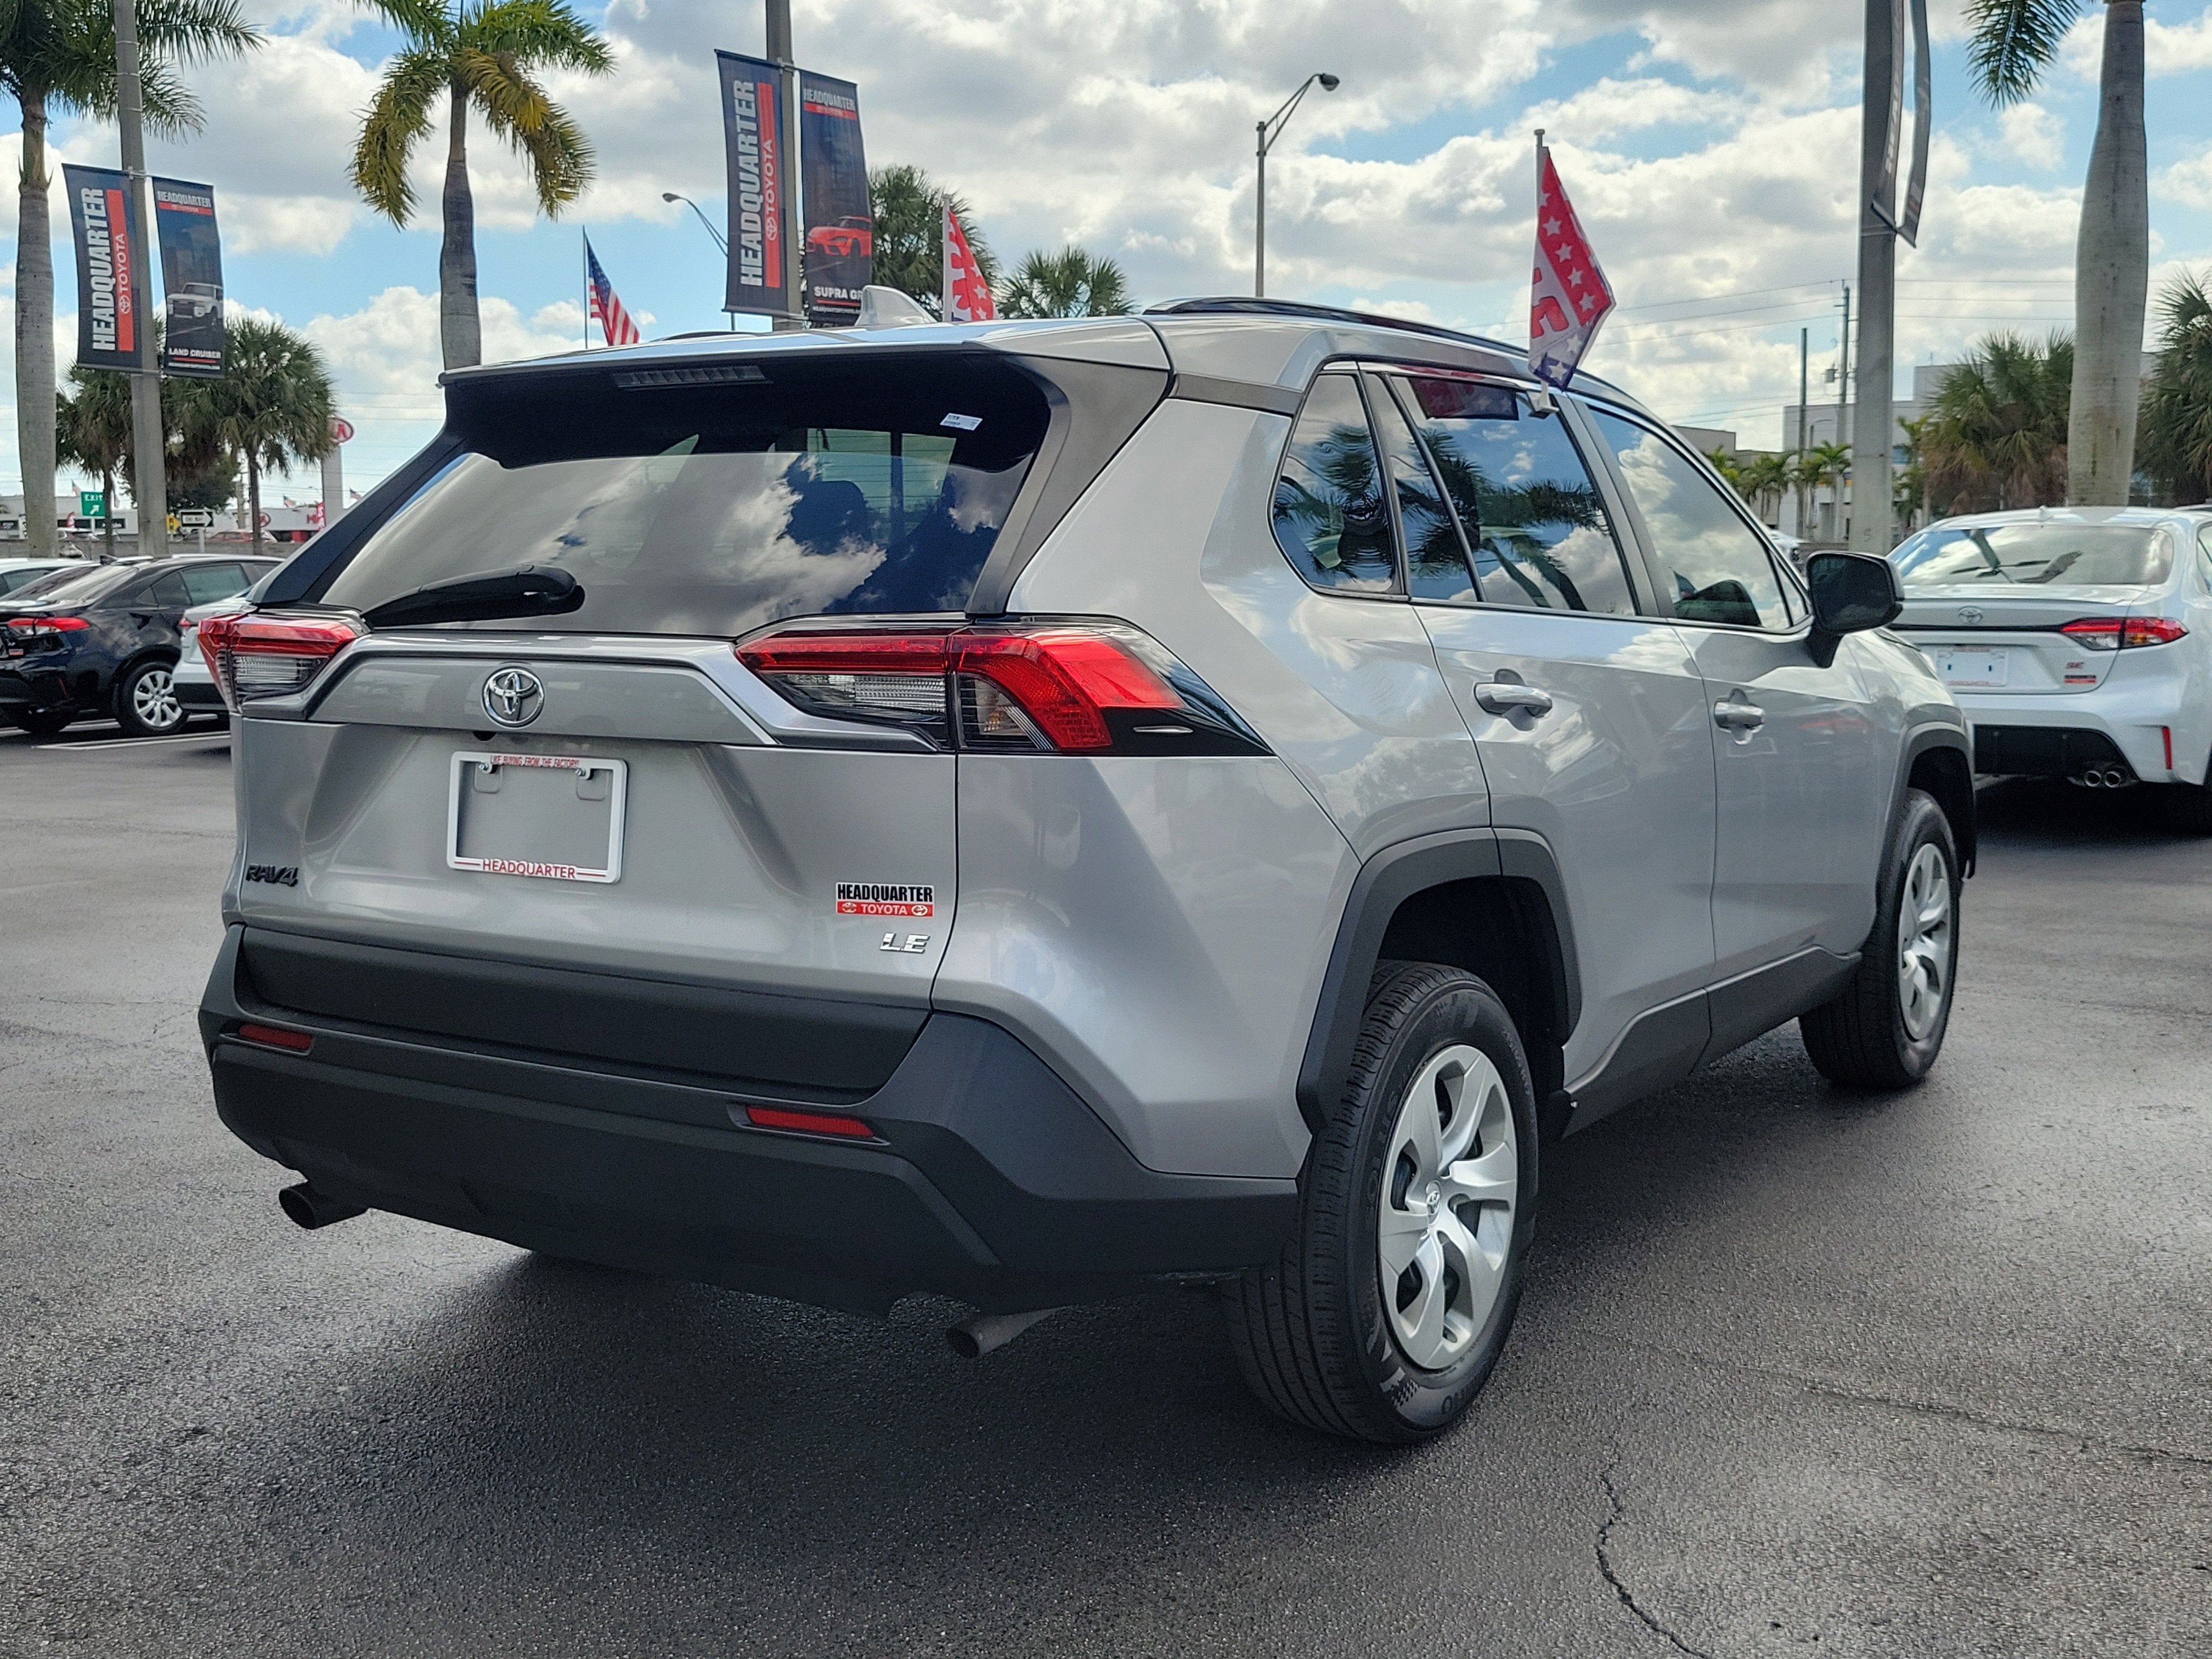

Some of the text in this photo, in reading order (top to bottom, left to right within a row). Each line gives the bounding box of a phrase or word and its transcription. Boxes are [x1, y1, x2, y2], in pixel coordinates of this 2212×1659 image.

[734, 80, 764, 286] HEADQUARTER
[764, 139, 776, 215] TOYOTA
[81, 188, 116, 351] HEADQUARTER
[115, 233, 128, 293] TOYOTA
[814, 286, 848, 300] SUPRA
[168, 347, 189, 356] LAND
[490, 755, 501, 765] LIKE
[503, 756, 522, 766] BUYING
[524, 757, 540, 767] FROM
[542, 758, 552, 768] THE
[245, 865, 298, 887] RAV4
[483, 859, 575, 878] HEADQUARTER
[837, 884, 933, 902] HEADQUARTER
[861, 904, 908, 915] TOYOTA
[879, 932, 931, 954] LE
